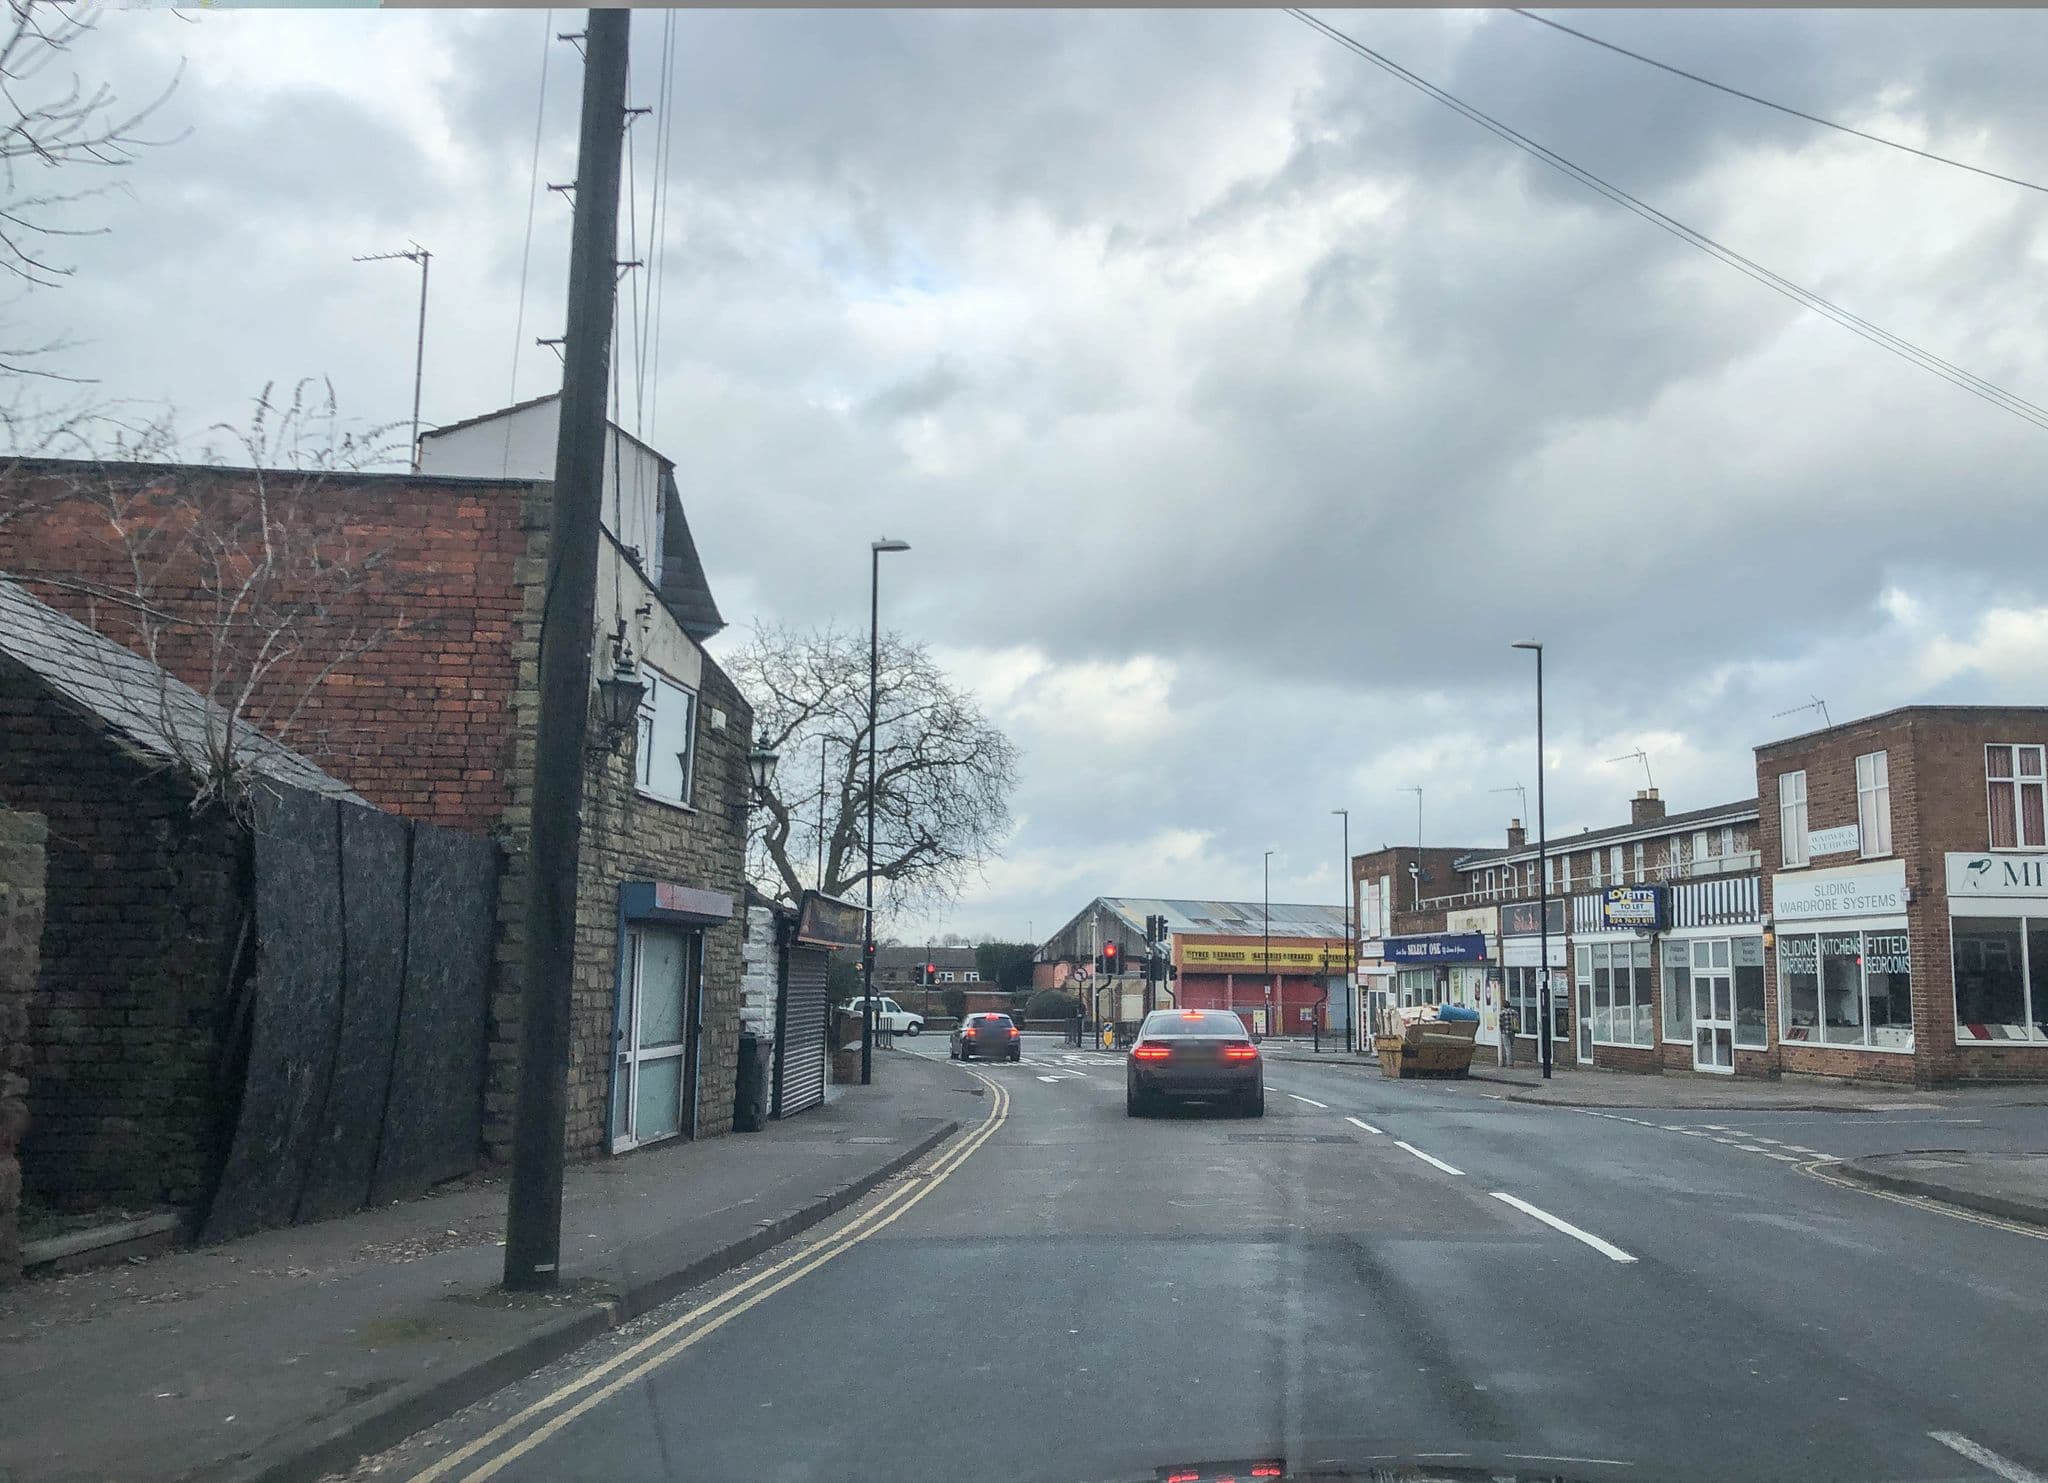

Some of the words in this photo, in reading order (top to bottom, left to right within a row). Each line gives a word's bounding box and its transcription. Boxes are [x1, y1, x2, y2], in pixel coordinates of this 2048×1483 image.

[1811, 831, 1855, 842] WARWICK
[2003, 861, 2048, 886] MI
[1608, 890, 1654, 900] LOVEITTS
[1814, 882, 1856, 897] SLIDING
[1780, 898, 1838, 913] WARDROBE
[1843, 894, 1897, 910] SYSTEMS
[1781, 939, 1818, 956] SLIDING
[1821, 938, 1861, 955] KITCHENS
[1866, 936, 1908, 955] FITTED
[1782, 957, 1818, 974] WARDROBES
[1866, 956, 1910, 974] BEDROOMS
